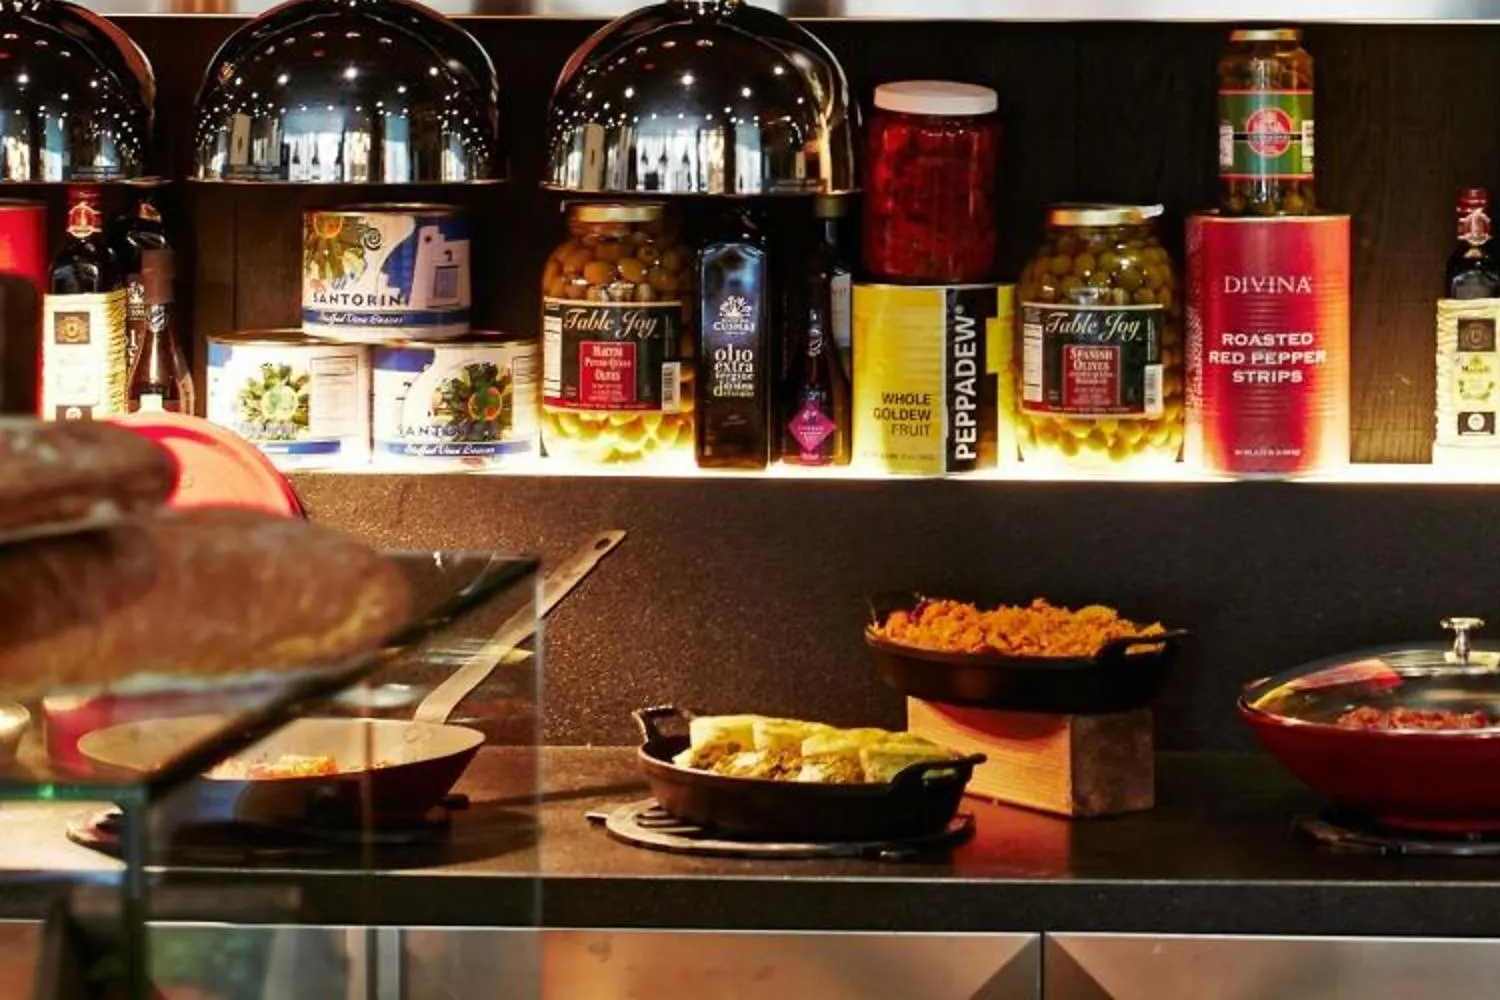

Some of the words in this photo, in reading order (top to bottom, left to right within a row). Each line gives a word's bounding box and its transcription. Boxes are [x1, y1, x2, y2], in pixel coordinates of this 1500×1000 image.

[1224, 275, 1313, 294] DIVINA
[564, 308, 615, 331] Table
[615, 311, 658, 338] Joy
[1045, 312, 1098, 334] Table
[1099, 312, 1141, 341] Joy
[1222, 333, 1313, 346] ROASTED
[715, 344, 753, 362] olio
[1209, 350, 1246, 364] RED
[1251, 350, 1328, 365] PEPPER
[714, 361, 753, 373] extra
[1232, 370, 1303, 383] STRIPS
[955, 315, 977, 462] PEPPADEW
[882, 392, 932, 406] WHOLE
[873, 408, 932, 421] GOLDEW
[891, 424, 931, 437] FRUIT
